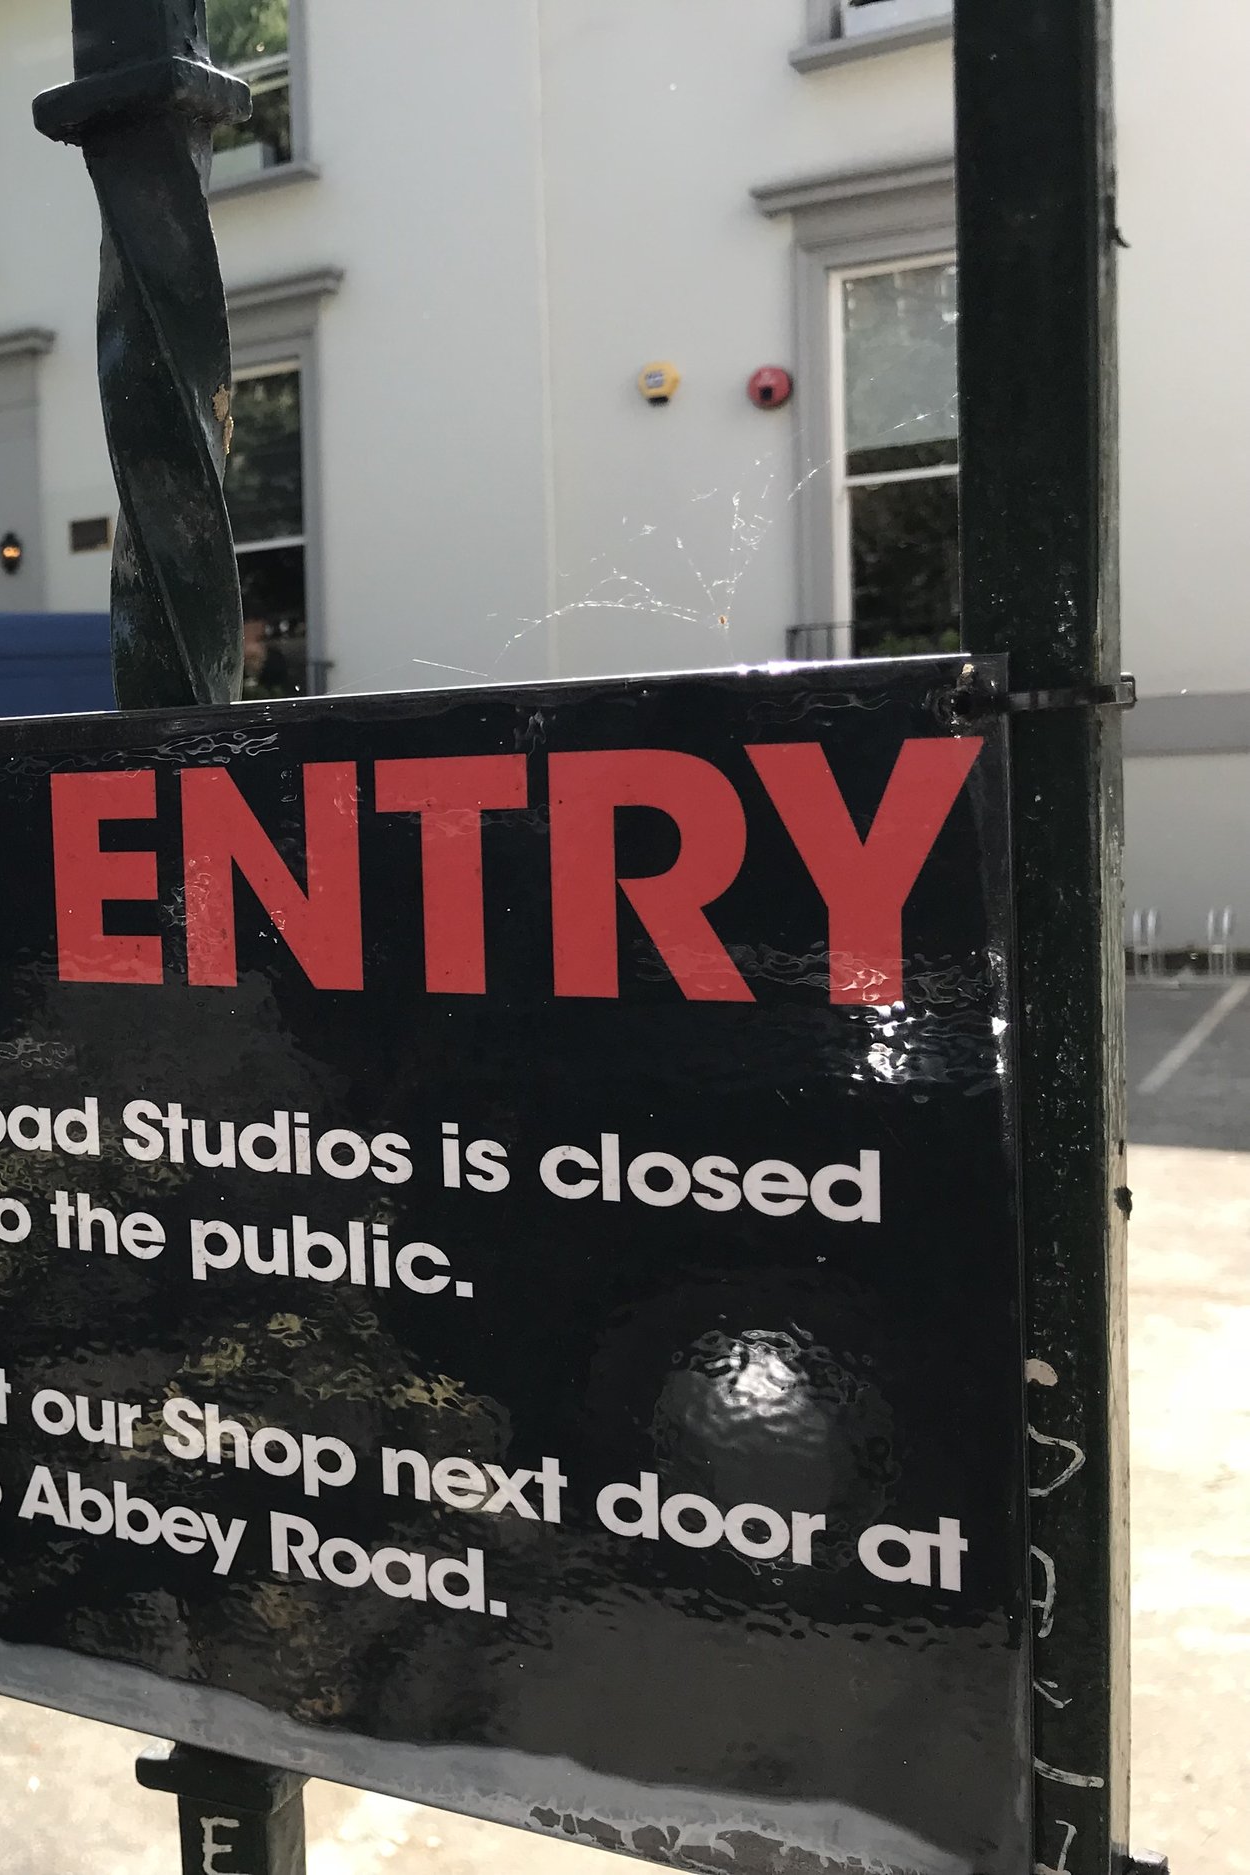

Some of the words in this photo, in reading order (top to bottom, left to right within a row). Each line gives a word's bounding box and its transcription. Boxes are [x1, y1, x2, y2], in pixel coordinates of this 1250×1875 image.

[51, 731, 983, 1006] ENTRY
[123, 1100, 413, 1184] Studios
[442, 1122, 510, 1193] is
[540, 1133, 881, 1223] closed
[50, 1191, 166, 1260] the
[190, 1215, 474, 1298] public.
[19, 1466, 247, 1575] Abbey
[270, 1512, 507, 1618] Road.
[31, 1389, 142, 1448] our
[163, 1398, 357, 1497] Shop
[382, 1447, 568, 1524] next
[596, 1472, 826, 1566] door
[857, 1517, 968, 1592] at
